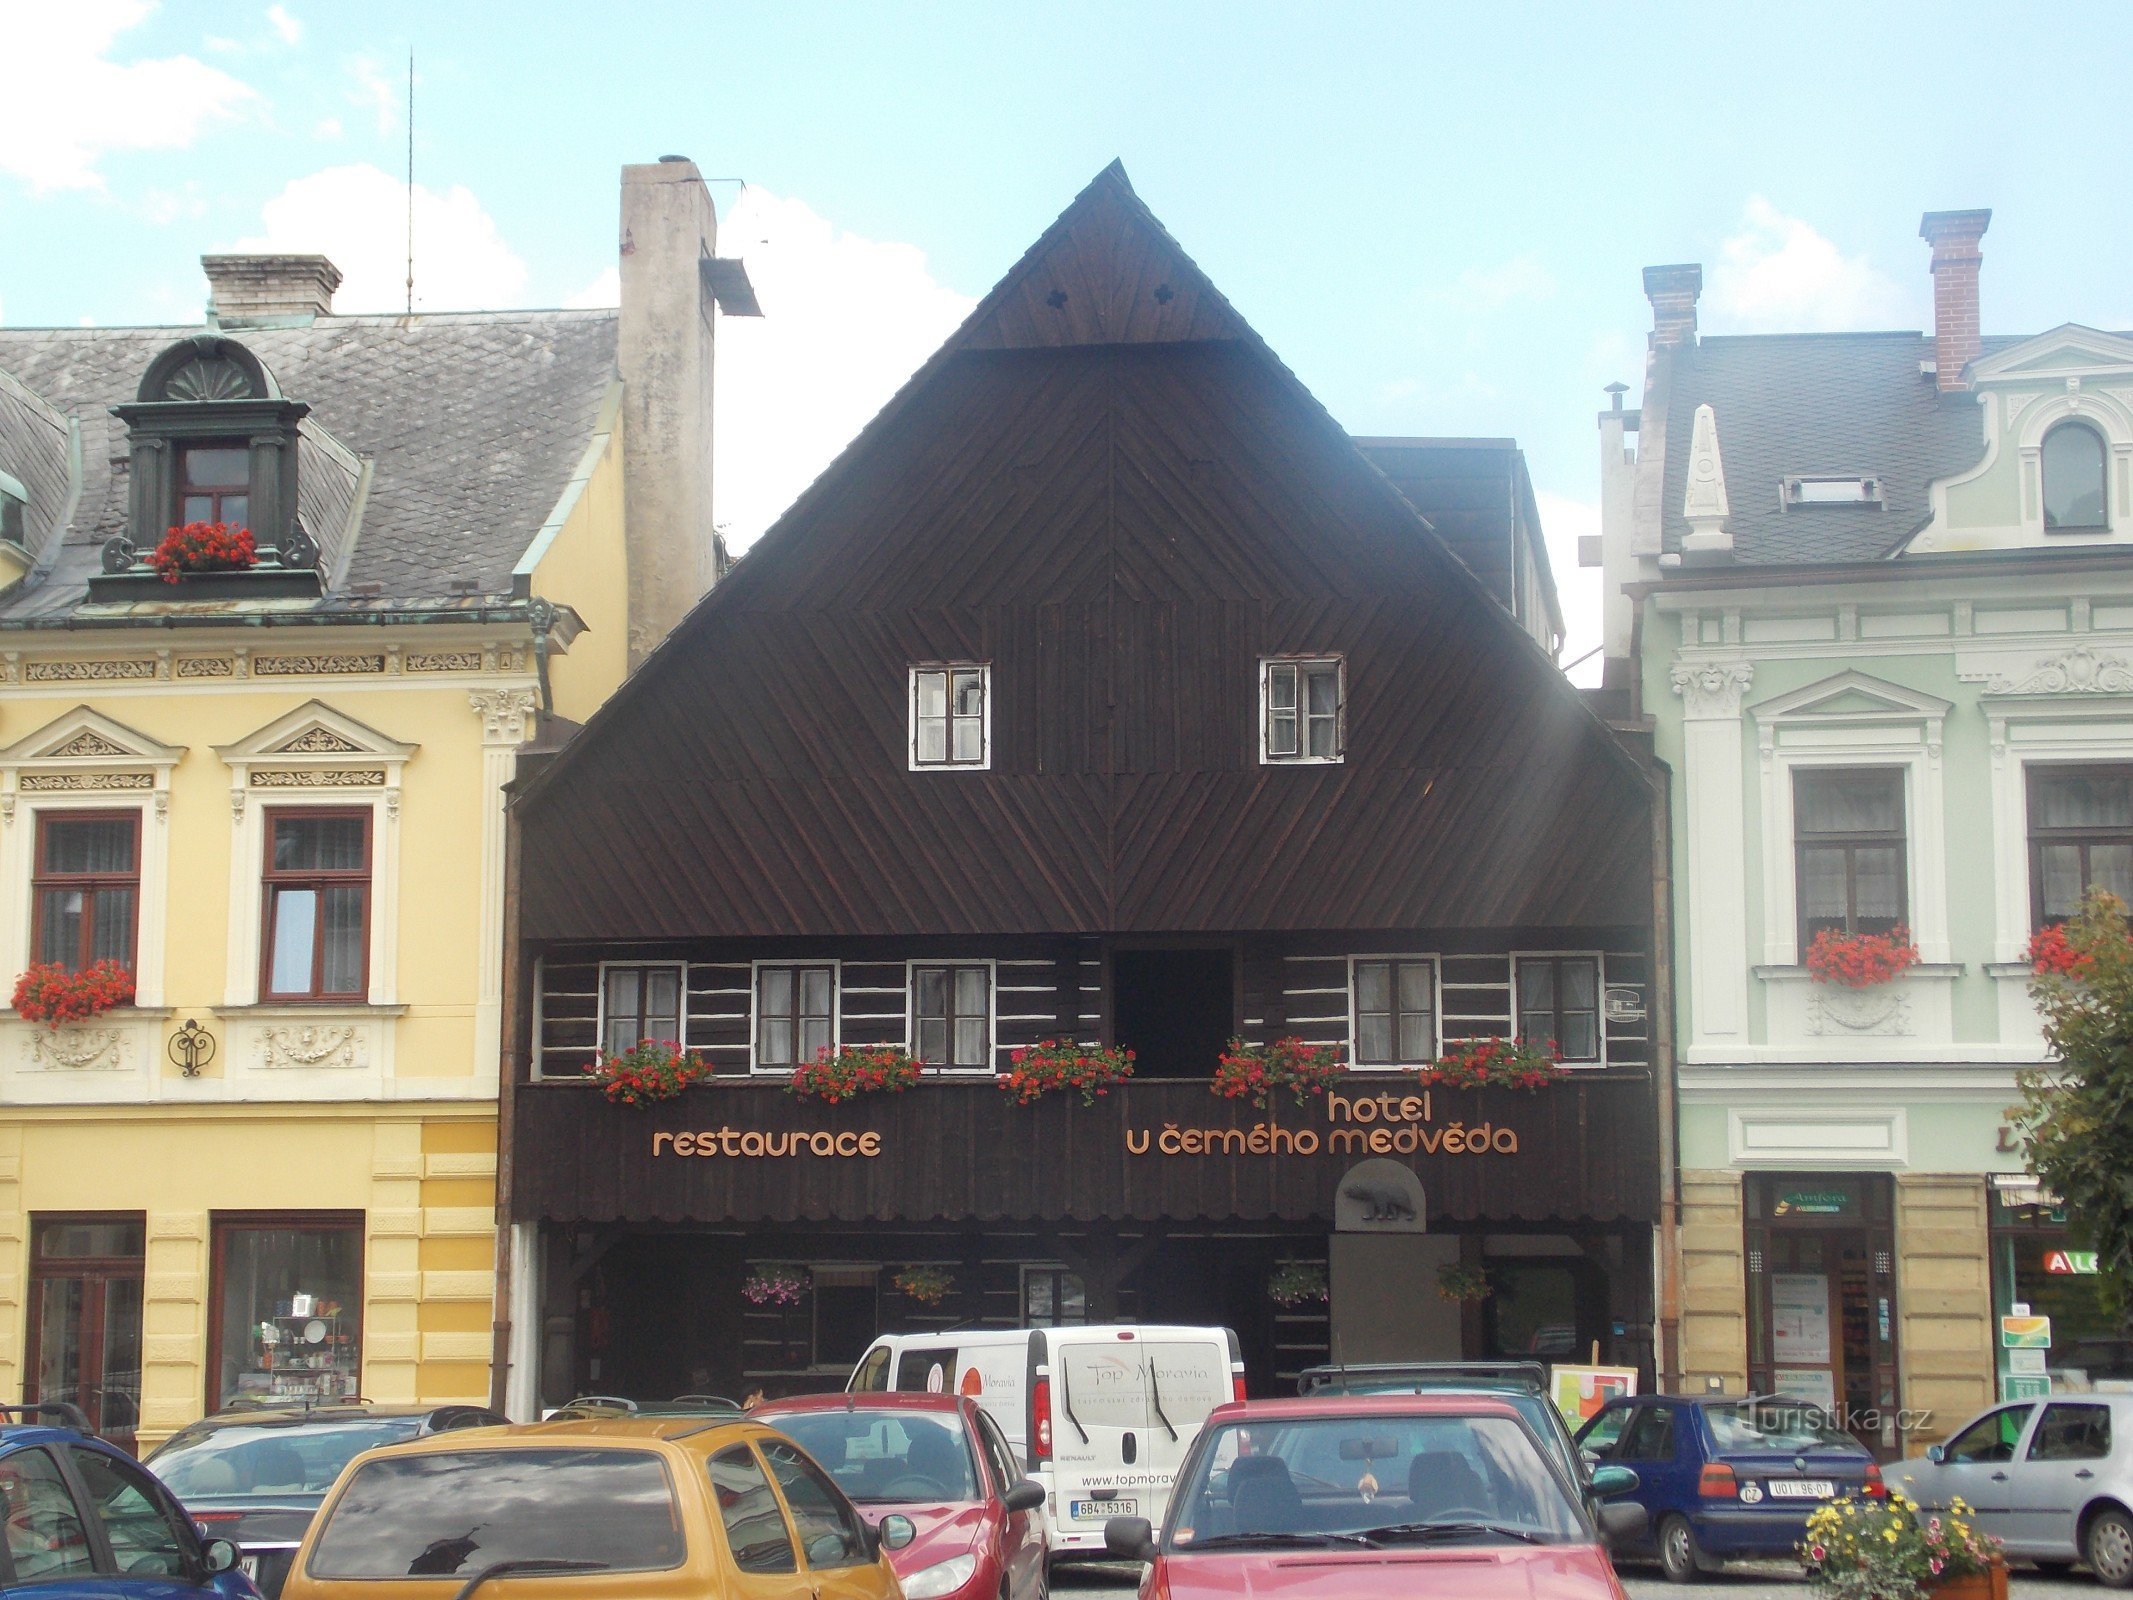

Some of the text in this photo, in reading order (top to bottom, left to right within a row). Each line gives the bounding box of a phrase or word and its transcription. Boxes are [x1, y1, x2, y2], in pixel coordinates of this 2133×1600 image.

[1328, 1090, 1431, 1123] hotel
[652, 1126, 882, 1157] restaurace
[1126, 1121, 1518, 1155] u černého medvěda
[983, 1374, 1015, 1389] Moravia
[1087, 1364, 1208, 1385] Top Moravia
[1744, 1489, 1757, 1501] CZ
[1080, 1503, 1100, 1515] 6B4
[1107, 1502, 1132, 1514] 5316
